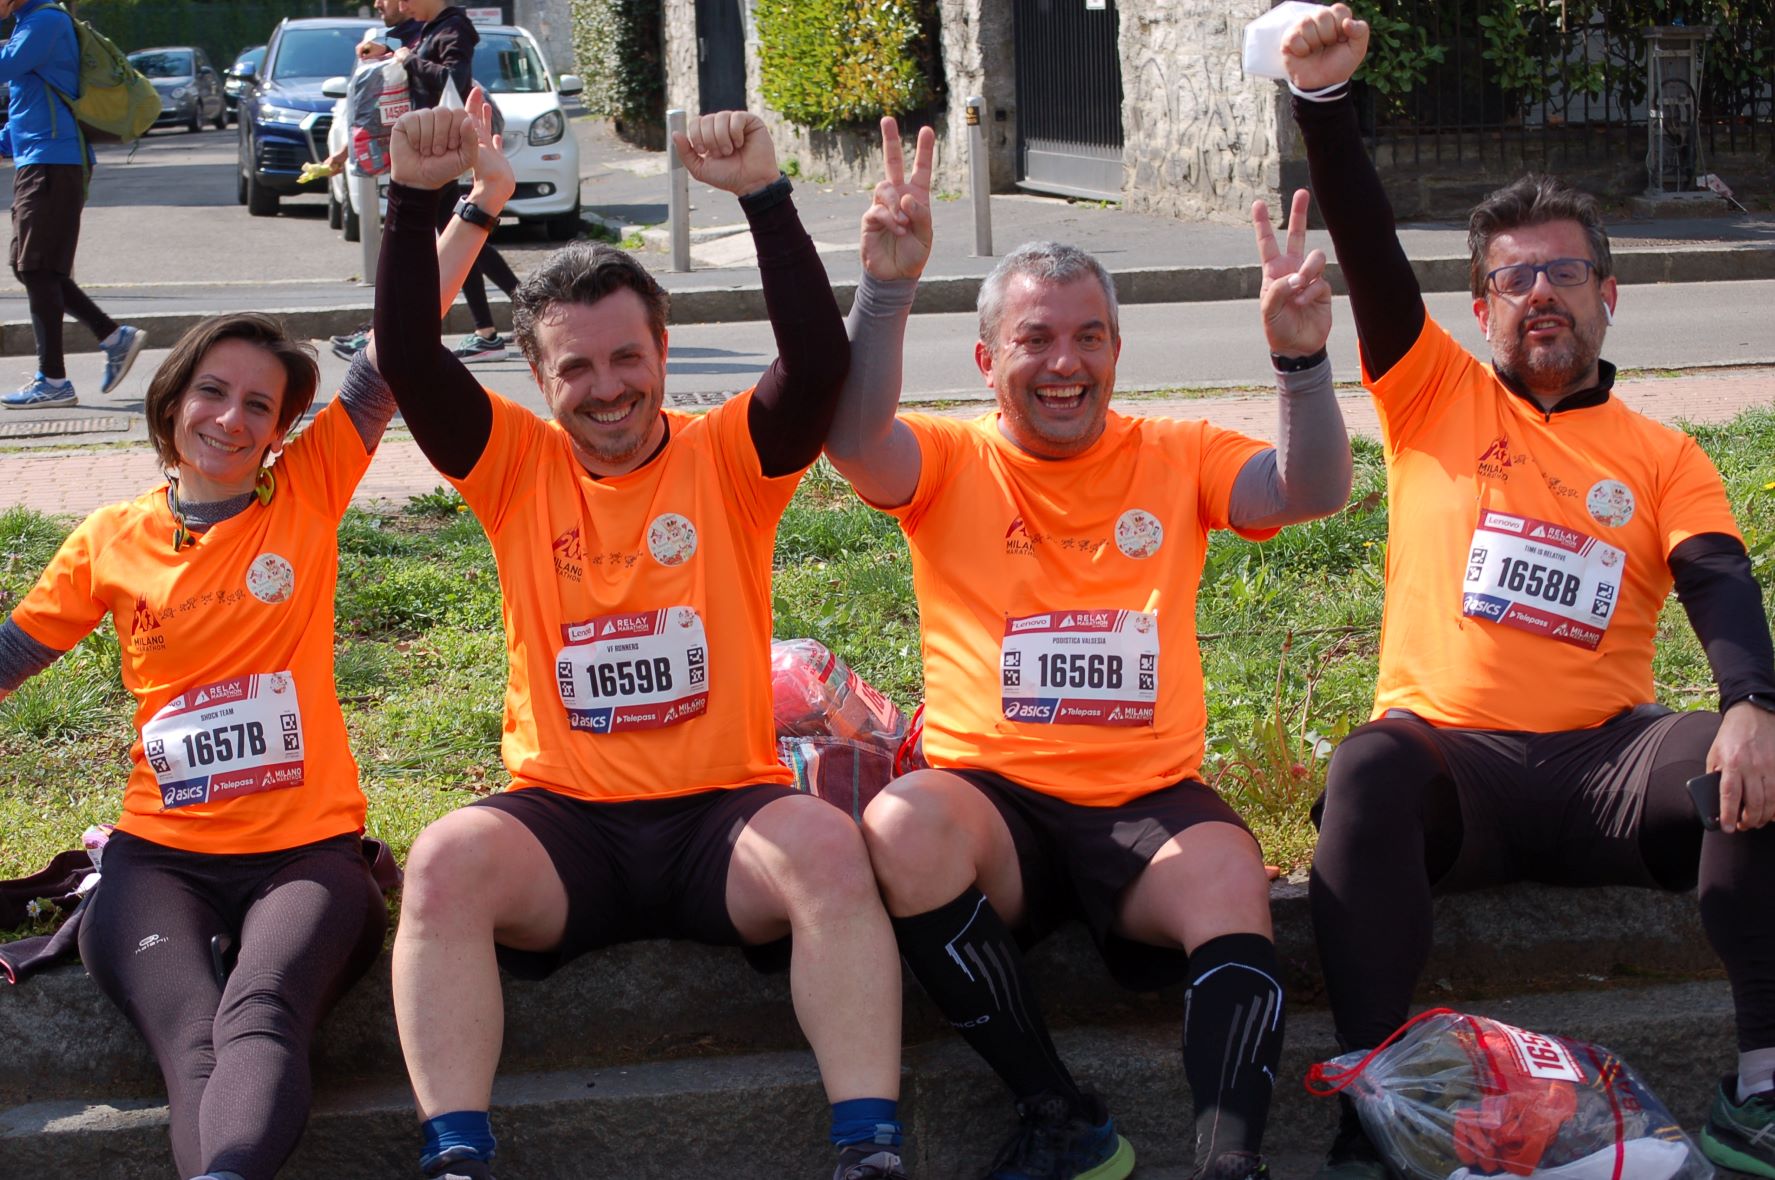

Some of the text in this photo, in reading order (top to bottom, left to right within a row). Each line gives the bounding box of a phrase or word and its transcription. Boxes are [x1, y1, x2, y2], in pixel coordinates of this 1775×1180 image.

[1488, 517, 1520, 529] Lenovo
[1548, 527, 1578, 541] RELAY
[1525, 545, 1537, 554] TIME
[1543, 550, 1566, 562] RELATIVE
[1497, 557, 1581, 607] 1658B
[616, 616, 648, 626] RELAY
[1076, 613, 1108, 621] RELAY
[1515, 611, 1549, 628] Telepass
[1015, 619, 1047, 629] Lenovo
[134, 634, 164, 646] MILANO
[1570, 626, 1599, 642] MILANO
[607, 643, 639, 653] VF RUNNERS
[586, 656, 673, 698] 1659B
[1038, 653, 1123, 689] 1656B
[209, 681, 240, 695] RELAY
[678, 698, 706, 711] MILANO
[200, 708, 234, 722] SHOCK TEAM
[623, 713, 656, 723] Telepass
[1067, 707, 1101, 717] Telepass
[1125, 708, 1153, 716] MILANO
[183, 721, 267, 768] 1657B
[274, 767, 302, 777] MILANO
[220, 778, 254, 790] Telepass
